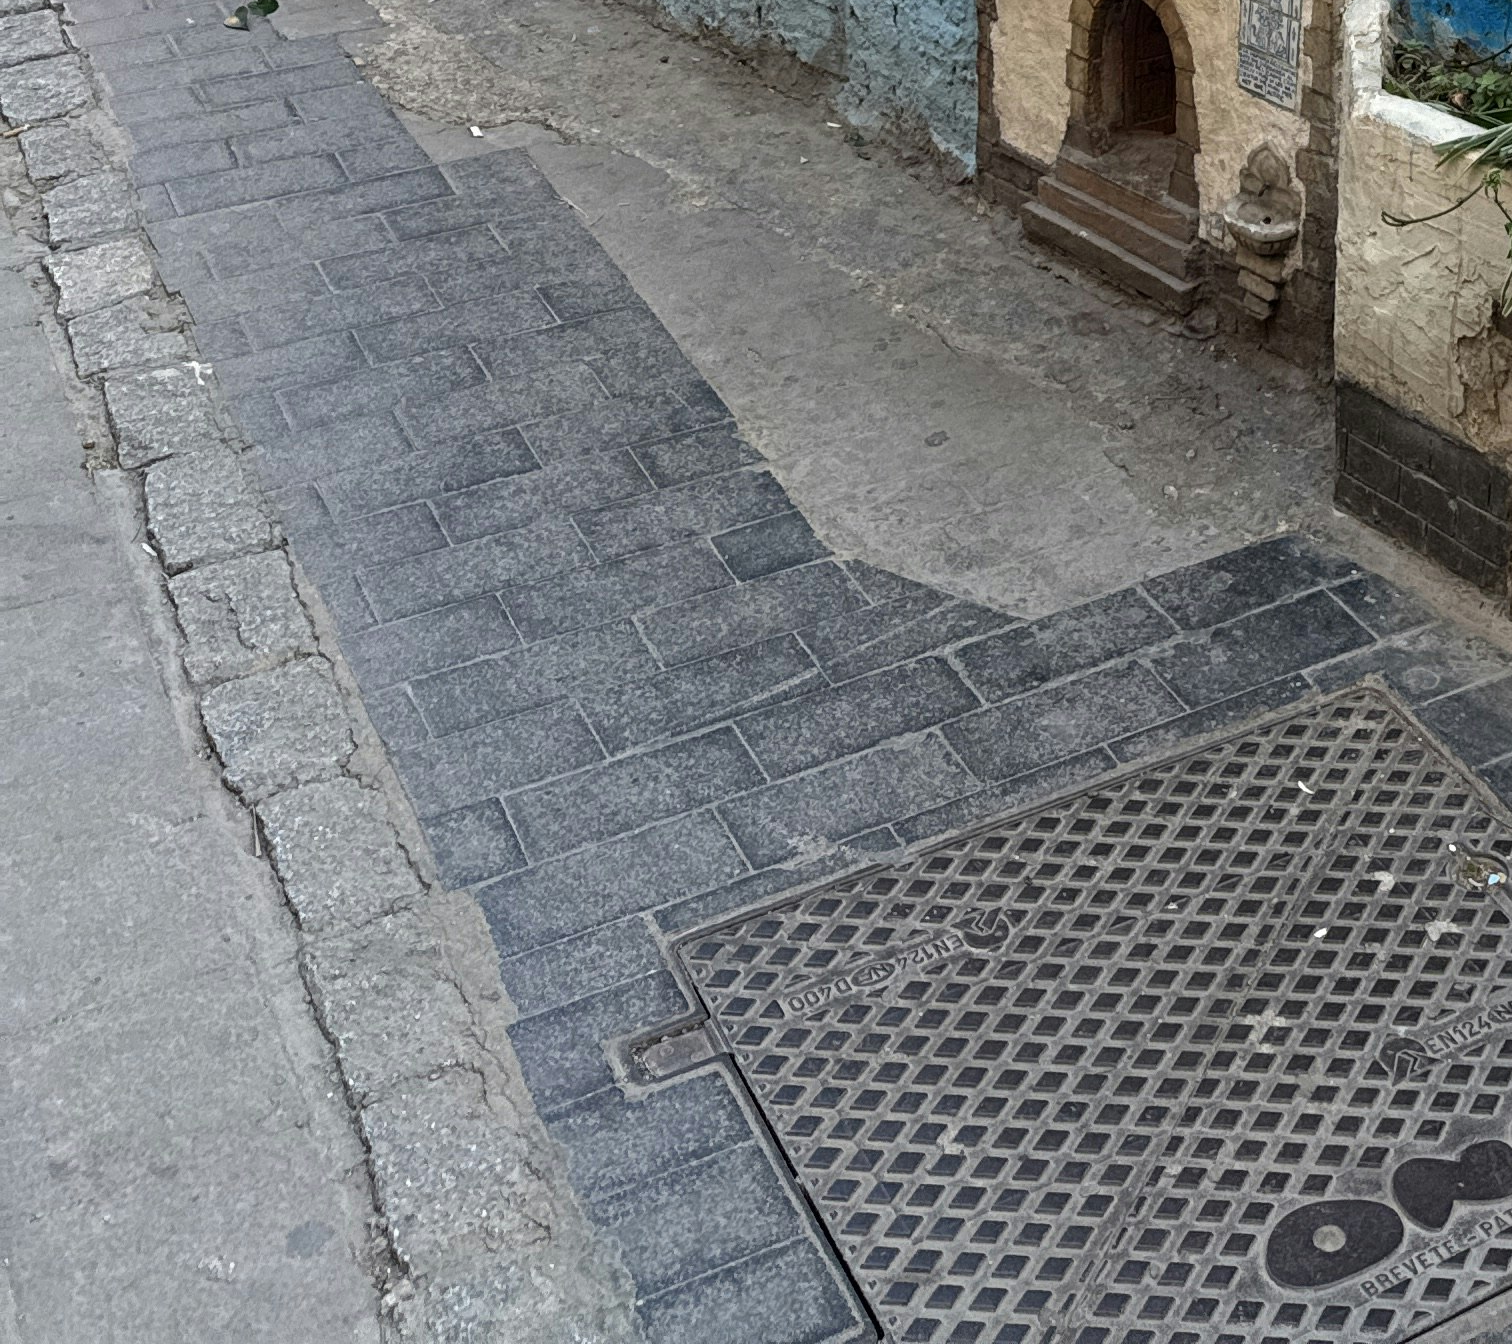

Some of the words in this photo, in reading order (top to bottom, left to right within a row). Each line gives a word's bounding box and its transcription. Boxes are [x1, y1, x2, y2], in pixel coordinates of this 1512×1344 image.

[895, 933, 966, 971] EN124
[787, 977, 853, 1012] D400
[1425, 1014, 1493, 1055] EN124
[1359, 1239, 1462, 1298] BREVETE
